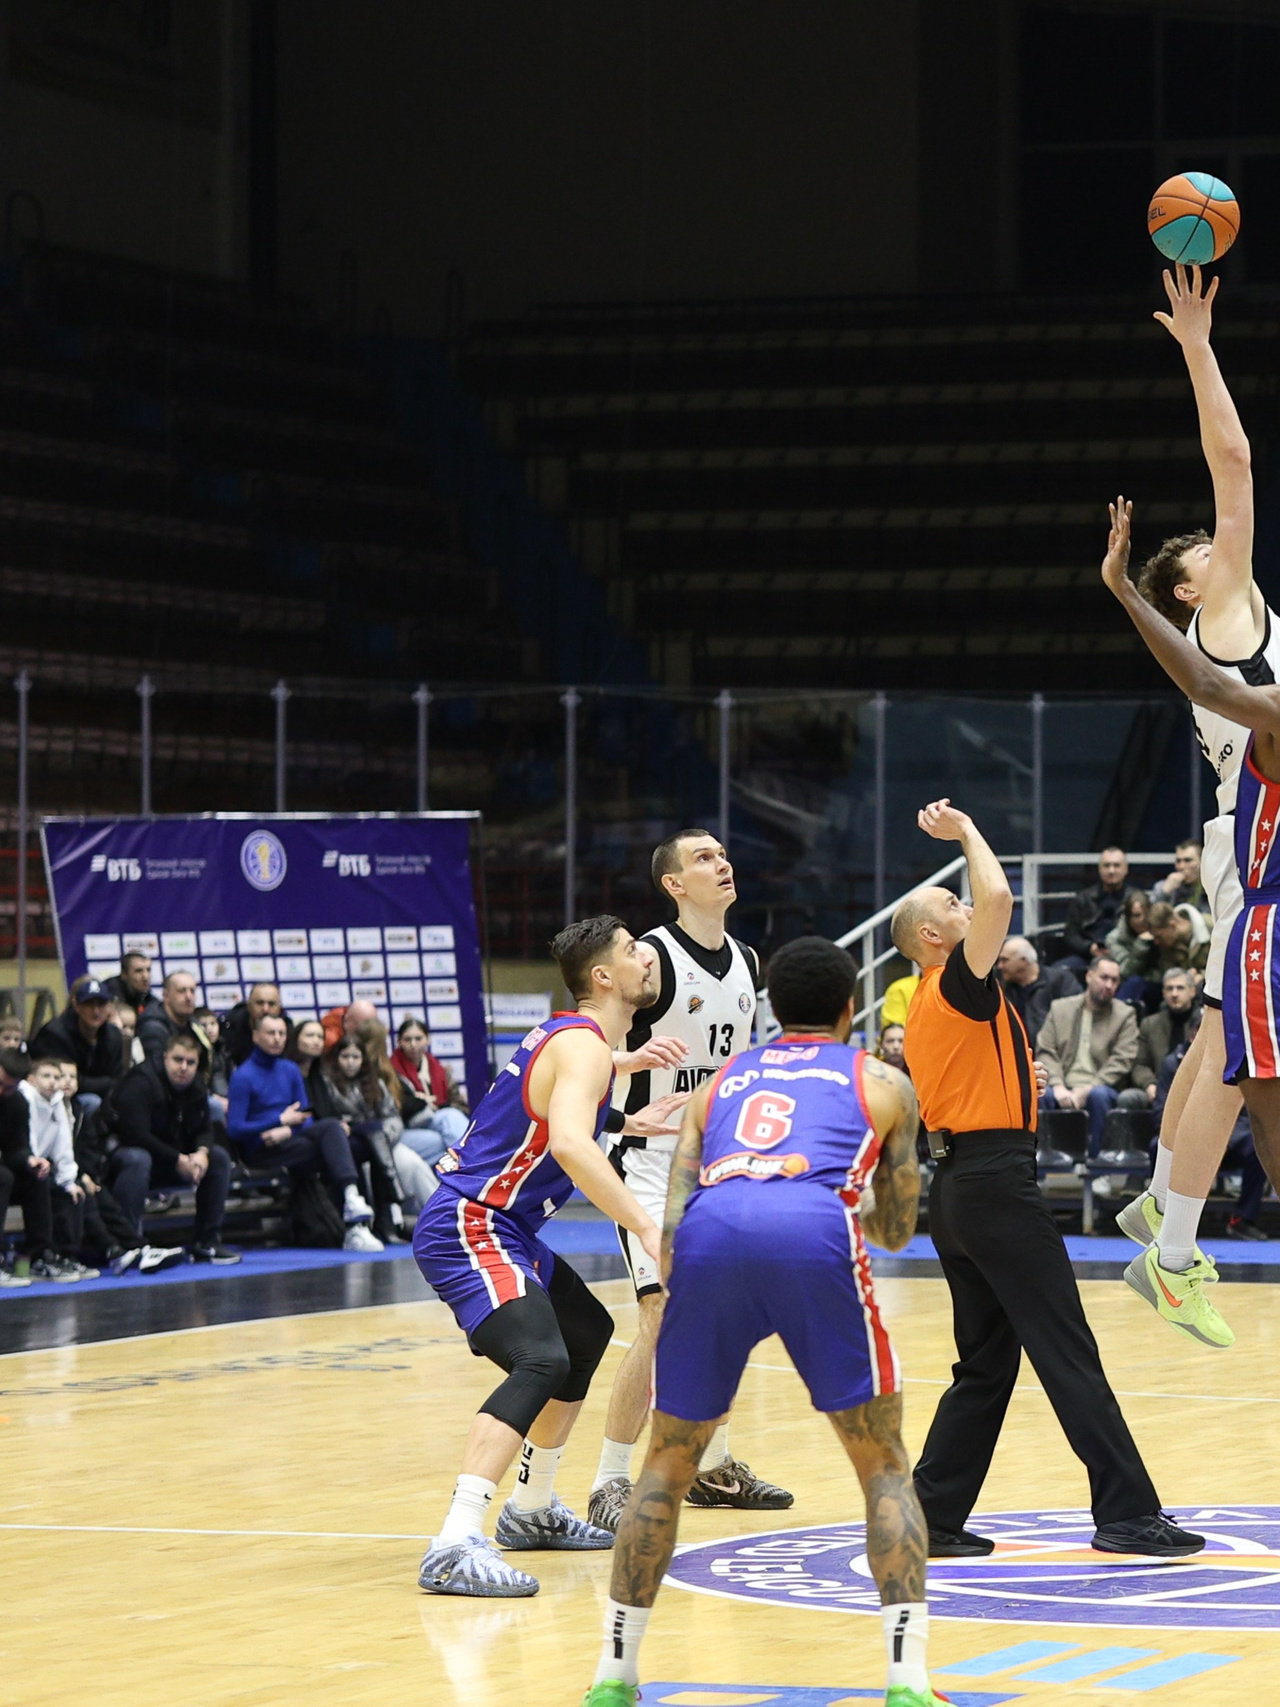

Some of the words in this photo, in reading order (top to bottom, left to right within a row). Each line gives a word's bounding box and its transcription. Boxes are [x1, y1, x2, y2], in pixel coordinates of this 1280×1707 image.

[107, 858, 142, 882] ВТБ
[338, 854, 371, 877] ВТБ
[708, 1023, 735, 1057] 13
[734, 1089, 797, 1150] 6
[1037, 1509, 1269, 1523] VB
